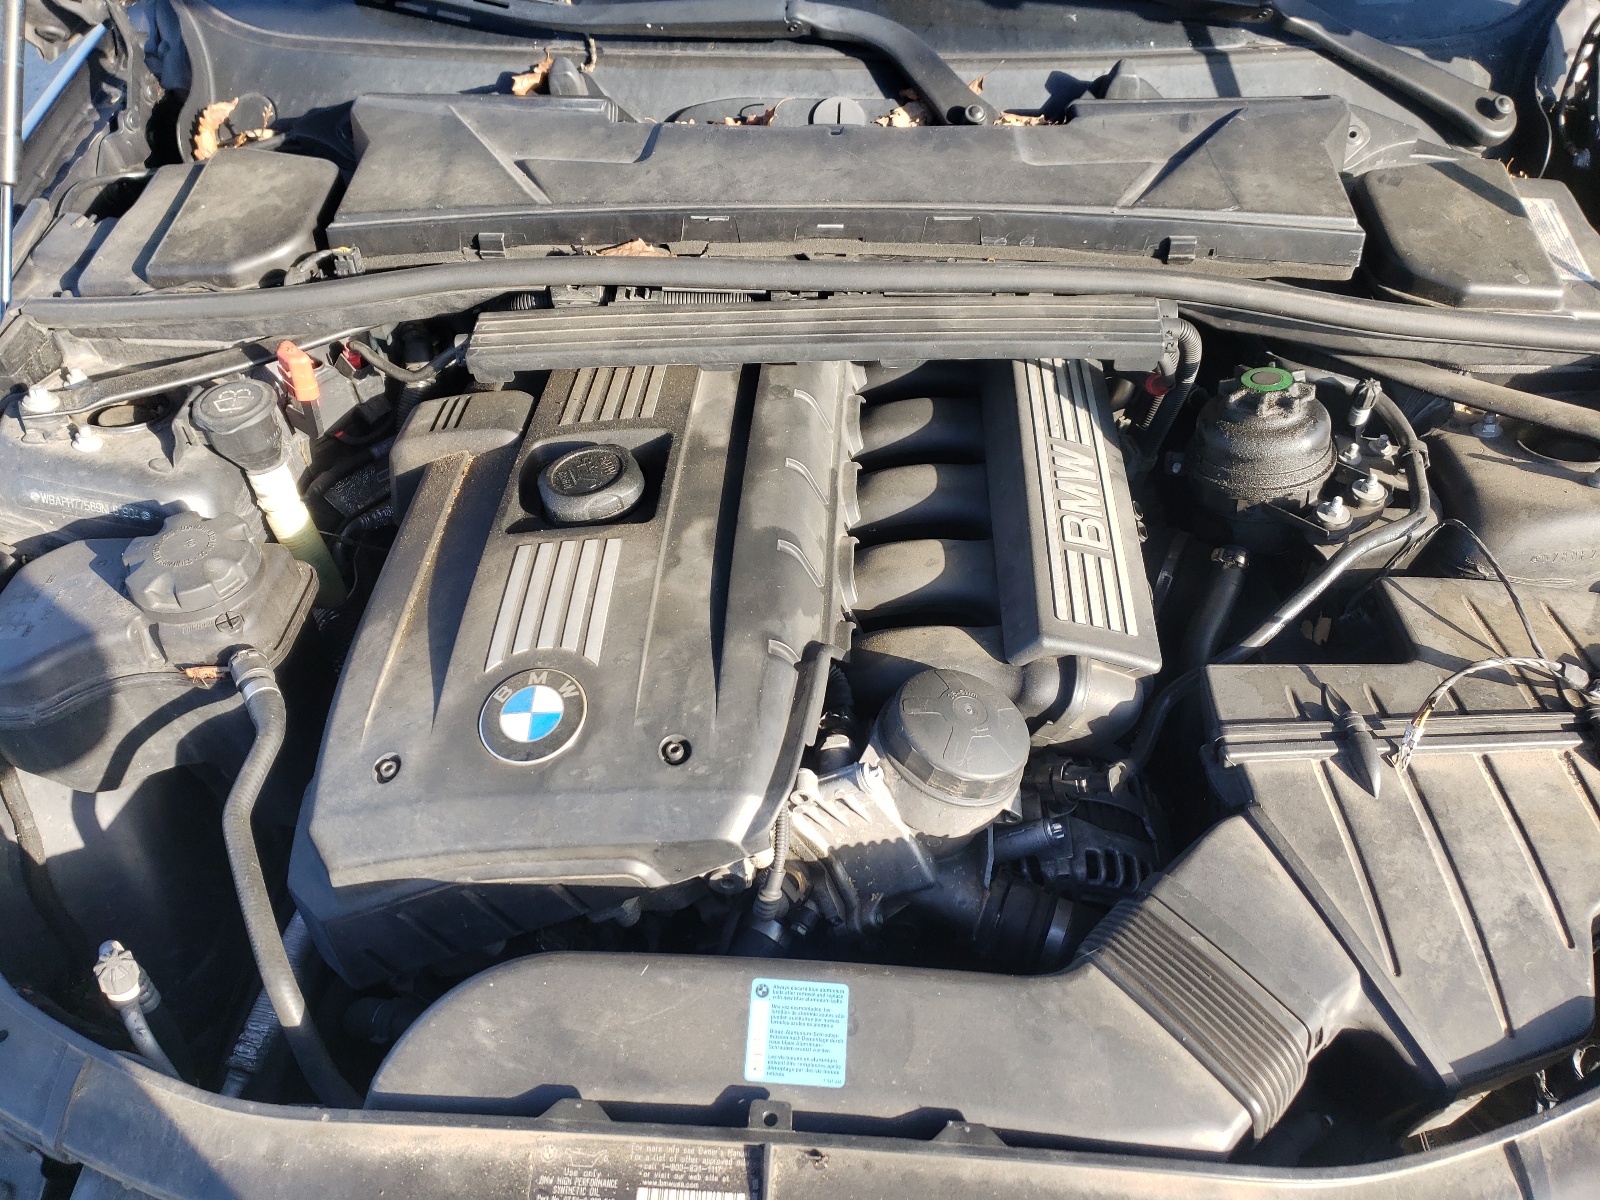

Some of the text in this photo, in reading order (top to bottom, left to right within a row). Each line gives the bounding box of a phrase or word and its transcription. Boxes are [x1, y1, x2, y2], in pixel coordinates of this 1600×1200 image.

[1051, 444, 1109, 551] BMW
[493, 671, 579, 703] BMW
[583, 1168, 602, 1178] only
[539, 1175, 618, 1188] BMW HIGH PERFORMANCE
[553, 1185, 586, 1195] SYNTHETIC
